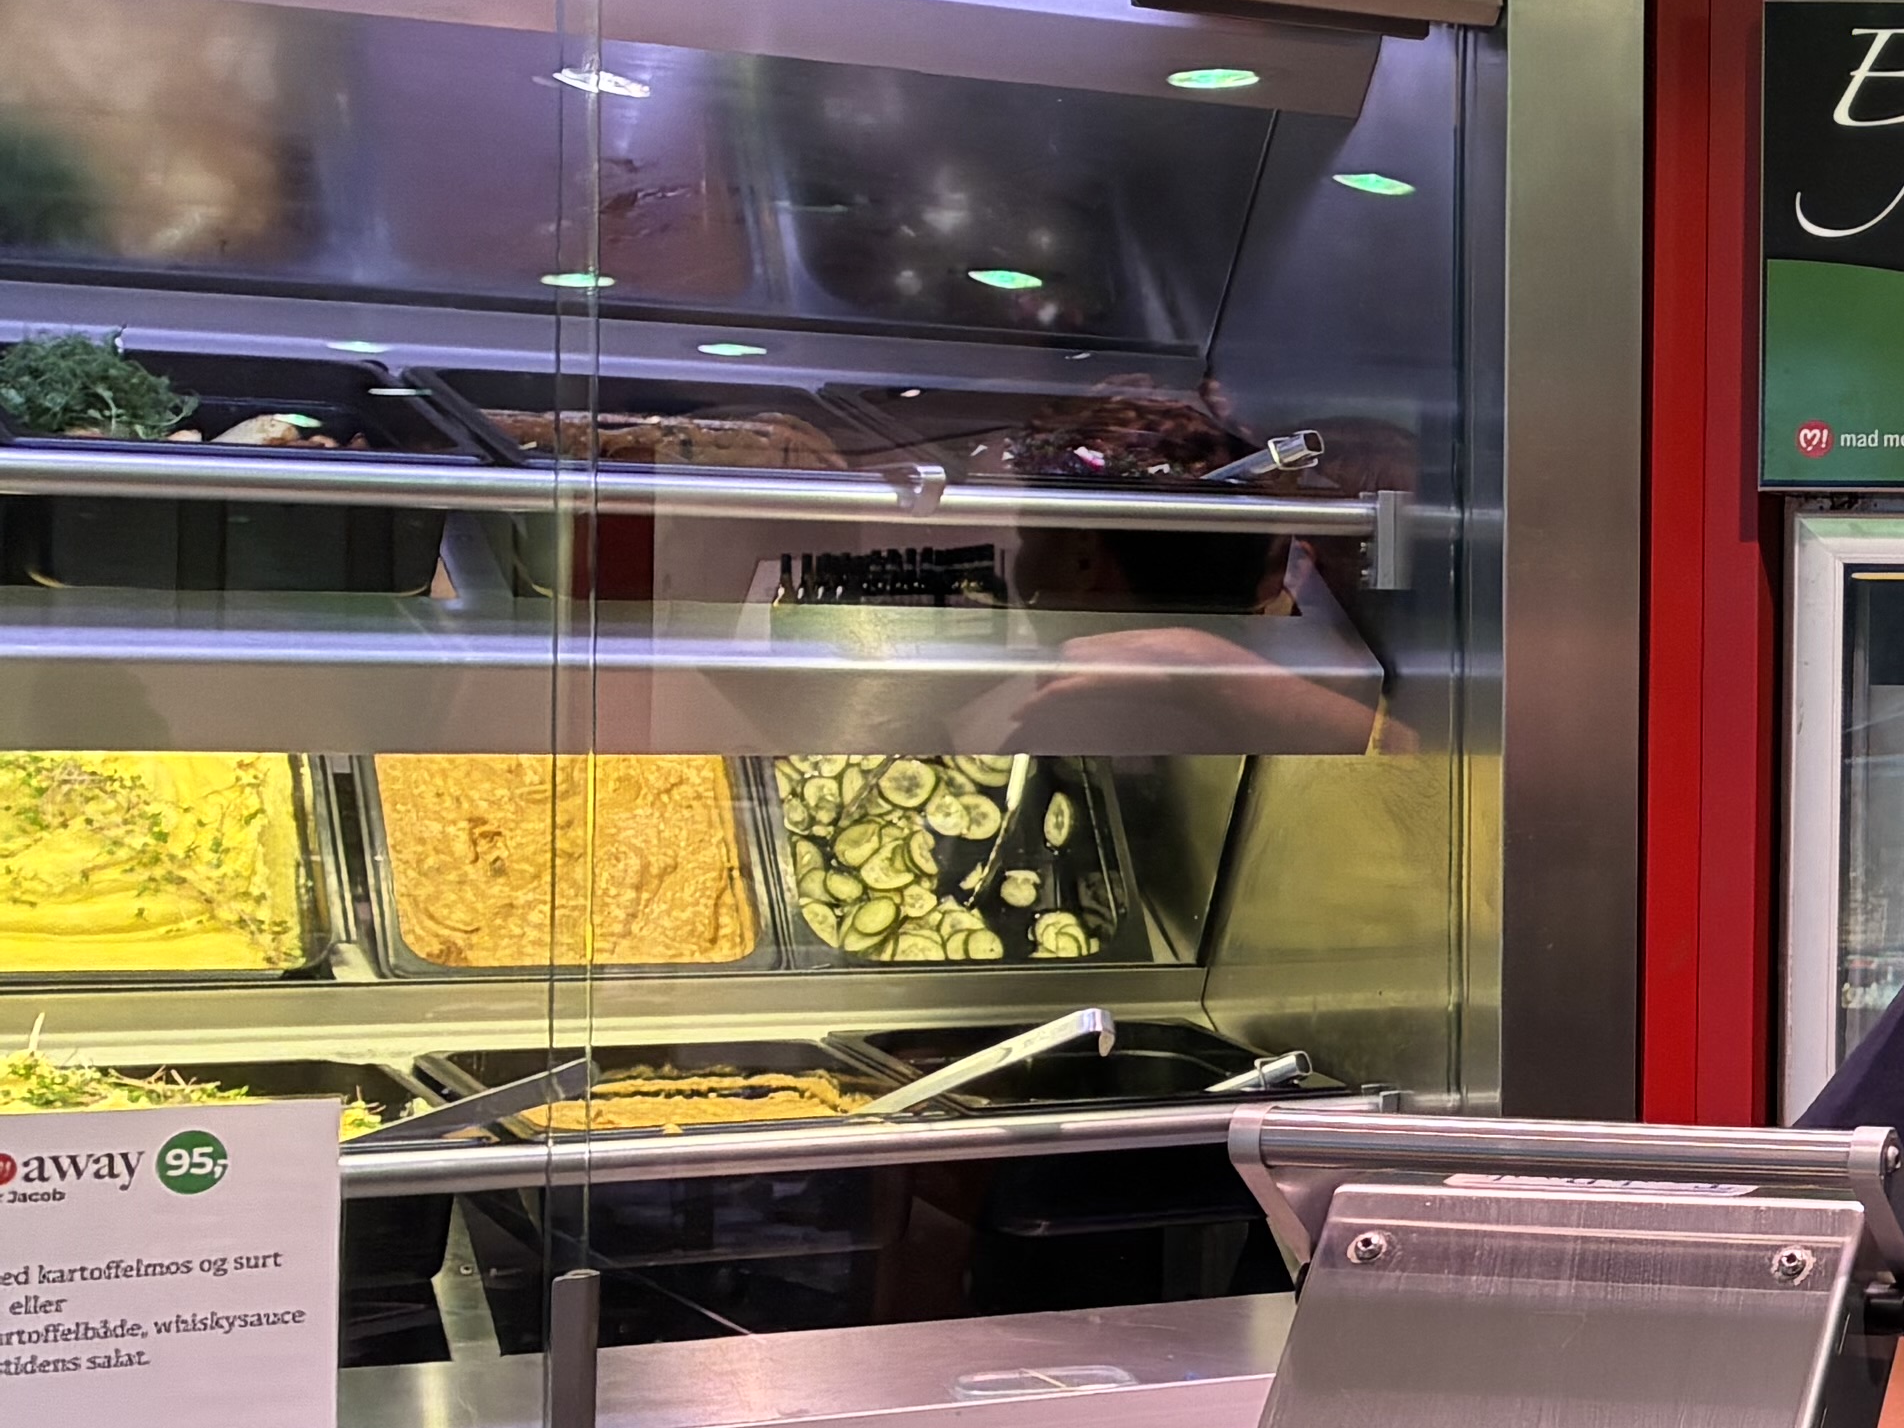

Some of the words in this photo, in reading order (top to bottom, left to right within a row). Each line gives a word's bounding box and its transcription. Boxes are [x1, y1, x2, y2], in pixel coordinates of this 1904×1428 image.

[1840, 429, 1879, 448] mad
[22, 1148, 146, 1191] away
[7, 1188, 67, 1204] Jacob
[37, 1258, 195, 1285] kartoffelmos
[199, 1257, 229, 1277] og
[233, 1251, 284, 1271] surt
[9, 1295, 68, 1316] eller
[153, 1308, 307, 1336] whiskysauce
